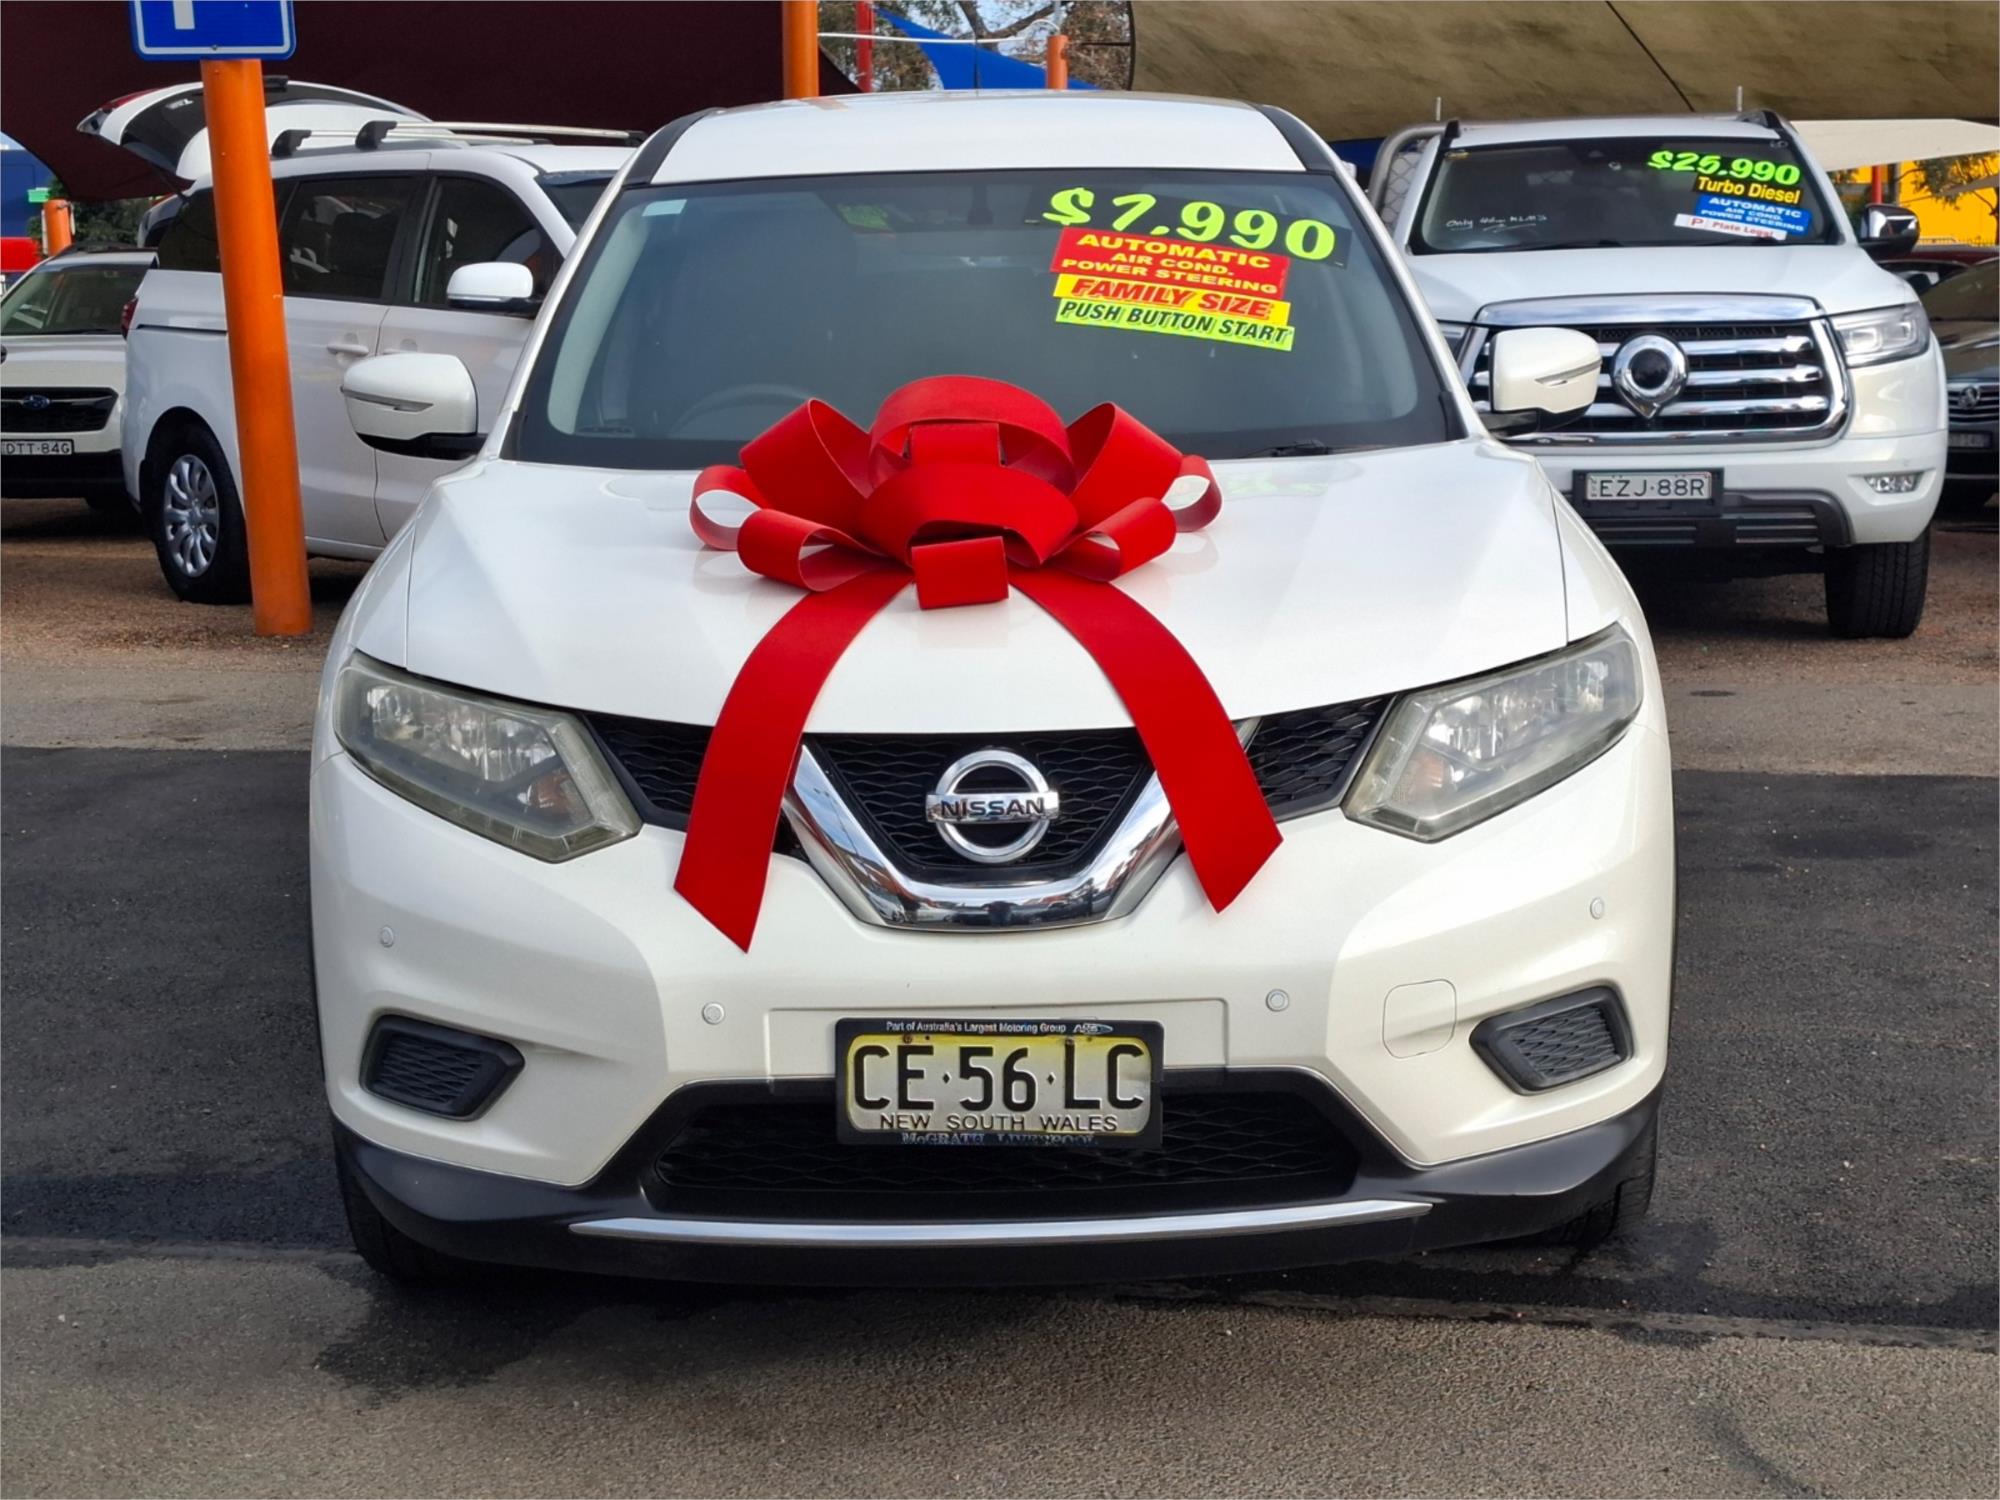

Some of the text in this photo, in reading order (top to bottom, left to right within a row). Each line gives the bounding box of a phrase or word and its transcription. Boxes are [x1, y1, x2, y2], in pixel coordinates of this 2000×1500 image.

[1698, 176, 1801, 204] Turbo Diesel
[1709, 197, 1802, 218] AUTOMATIC
[1725, 207, 1745, 215] AIR
[1691, 218, 1774, 238] P Plate Legal
[1701, 210, 1805, 231] POWER STEERING
[1077, 234, 1271, 269] AUTOMATIC
[1111, 252, 1235, 276] AIR COND.
[1061, 259, 1279, 294] POWER STEERING
[1071, 278, 1274, 319] FAMILY SIZE
[1060, 301, 1292, 343] PUSH BUTTON START
[941, 797, 1044, 817] NISSAN
[886, 1021, 1066, 1034] Part of Australia's Largest Motoring Group
[880, 1114, 1118, 1132] NEW SOUTH WALES
